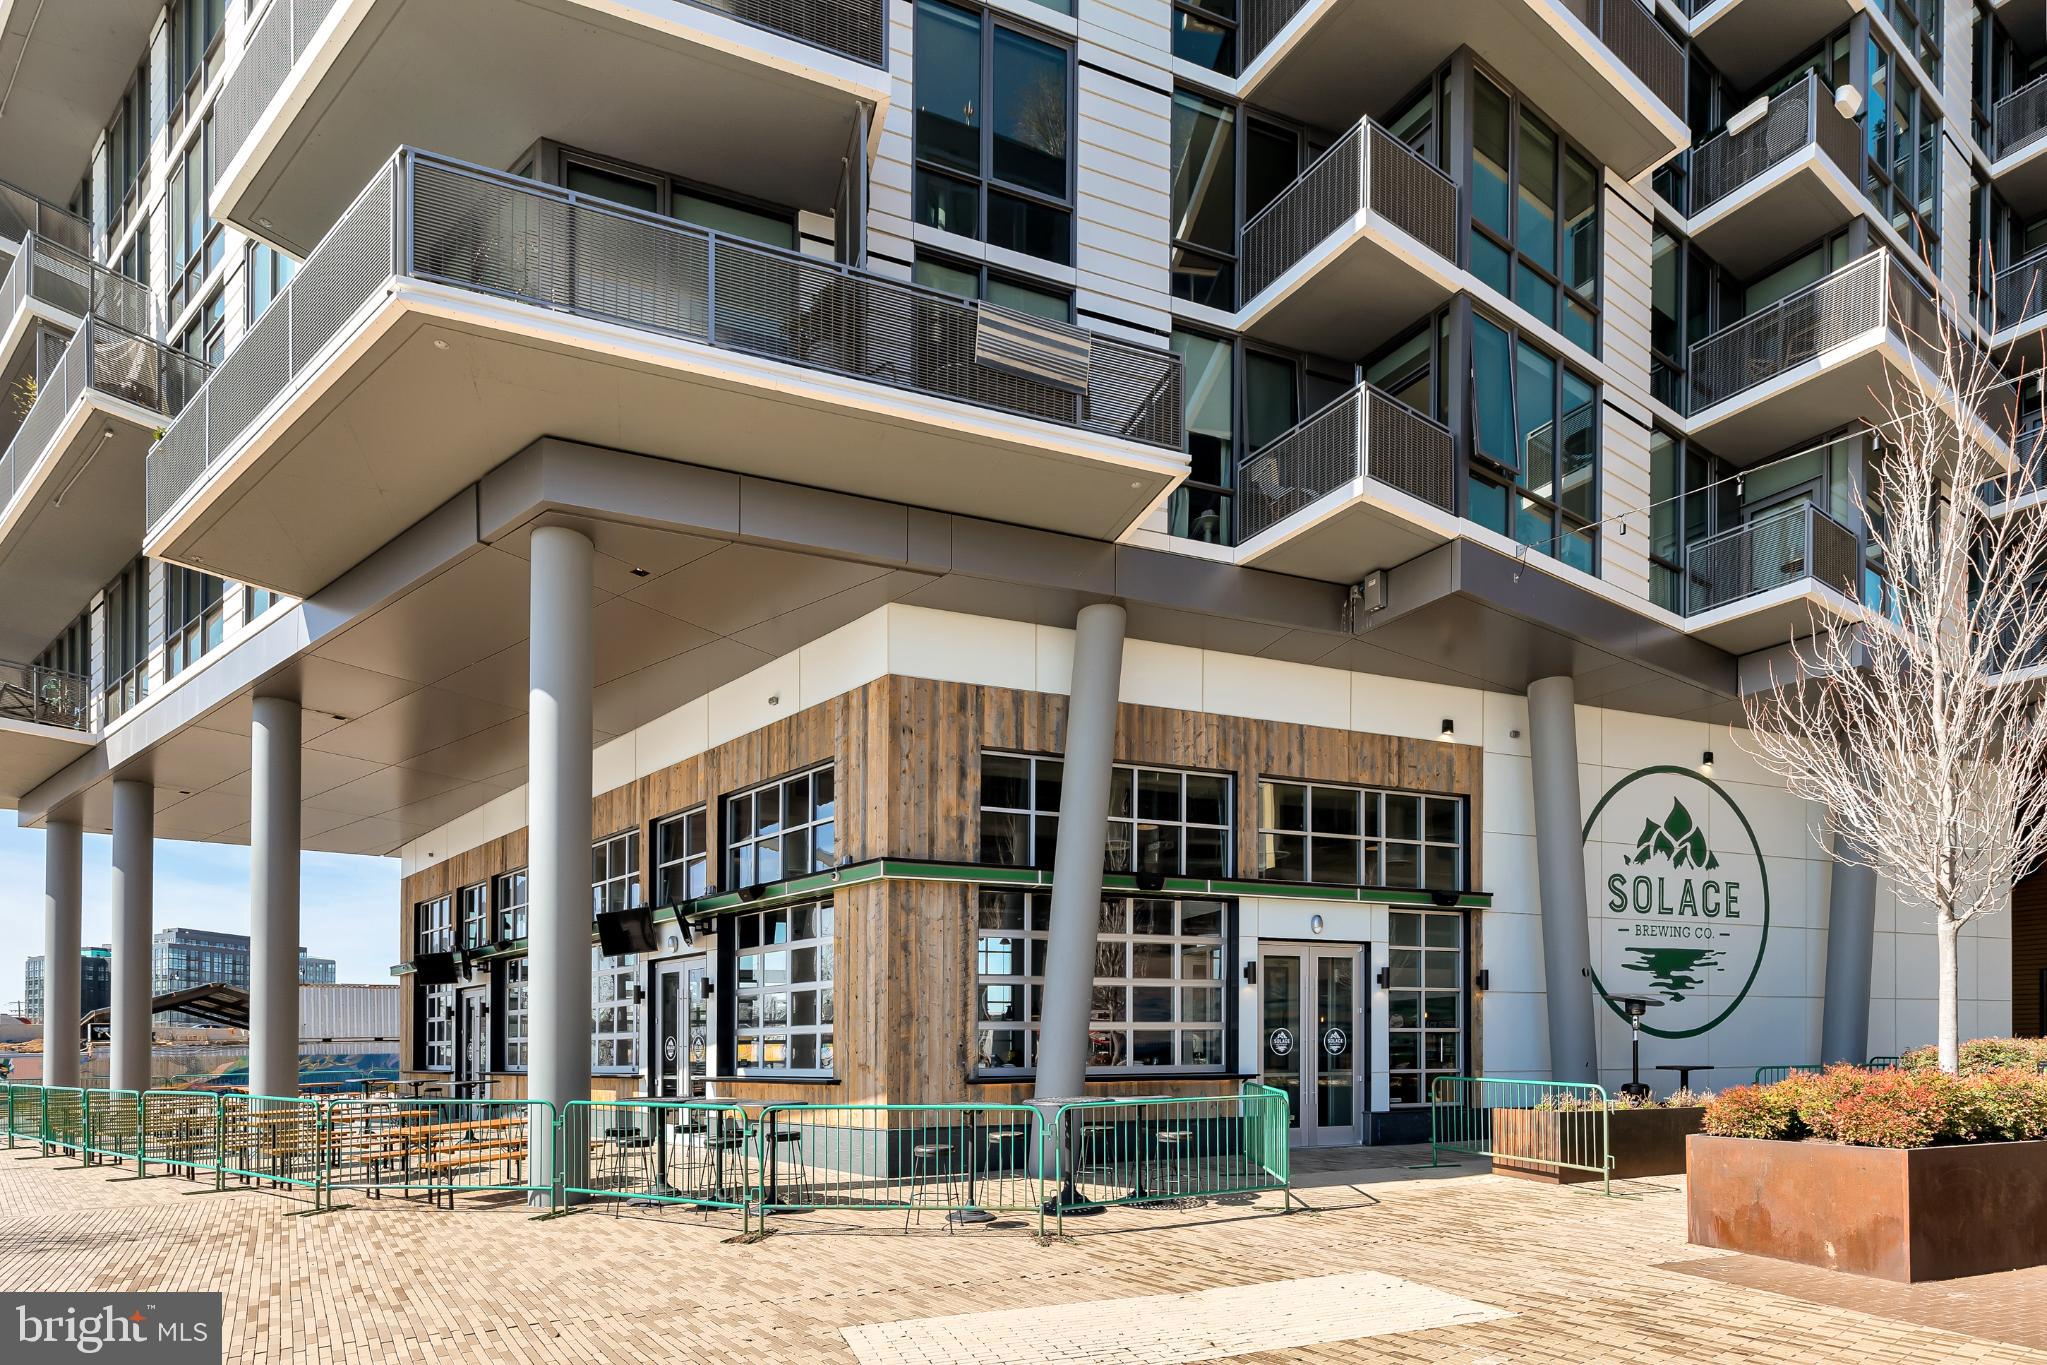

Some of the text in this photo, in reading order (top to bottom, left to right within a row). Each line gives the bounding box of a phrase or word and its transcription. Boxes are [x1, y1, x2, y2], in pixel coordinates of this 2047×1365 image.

[1607, 872, 1741, 919] SOLACE
[1635, 924, 1715, 940] BREWING CO.
